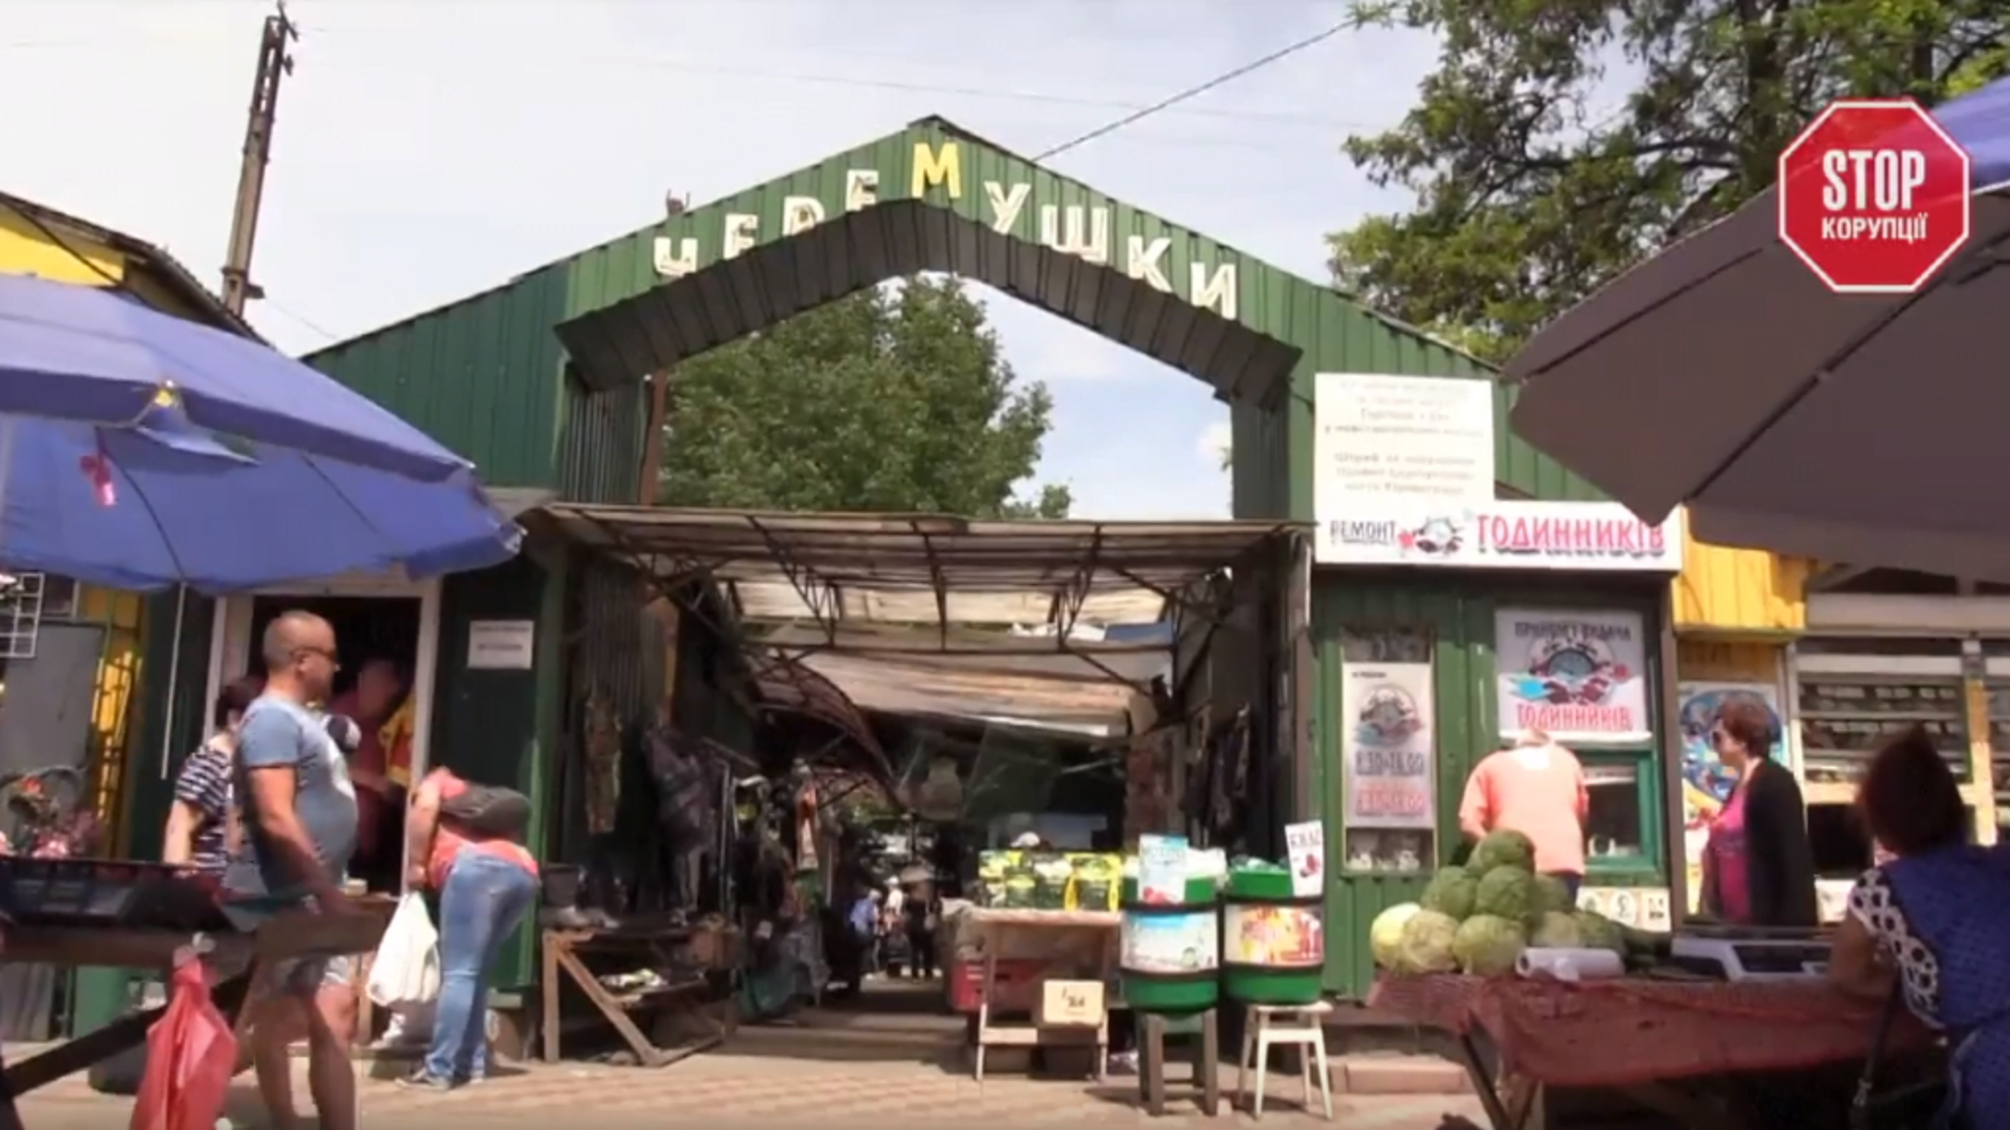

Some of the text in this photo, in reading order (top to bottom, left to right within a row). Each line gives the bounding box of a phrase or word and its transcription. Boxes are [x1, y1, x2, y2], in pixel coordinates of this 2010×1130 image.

[653, 142, 1237, 321] ЧЕРЕМУШКИ
[1330, 513, 1667, 556] РЕМОНТ ГОДИННИКІВ
[1516, 704, 1634, 732] ГОДИННИКІВ
